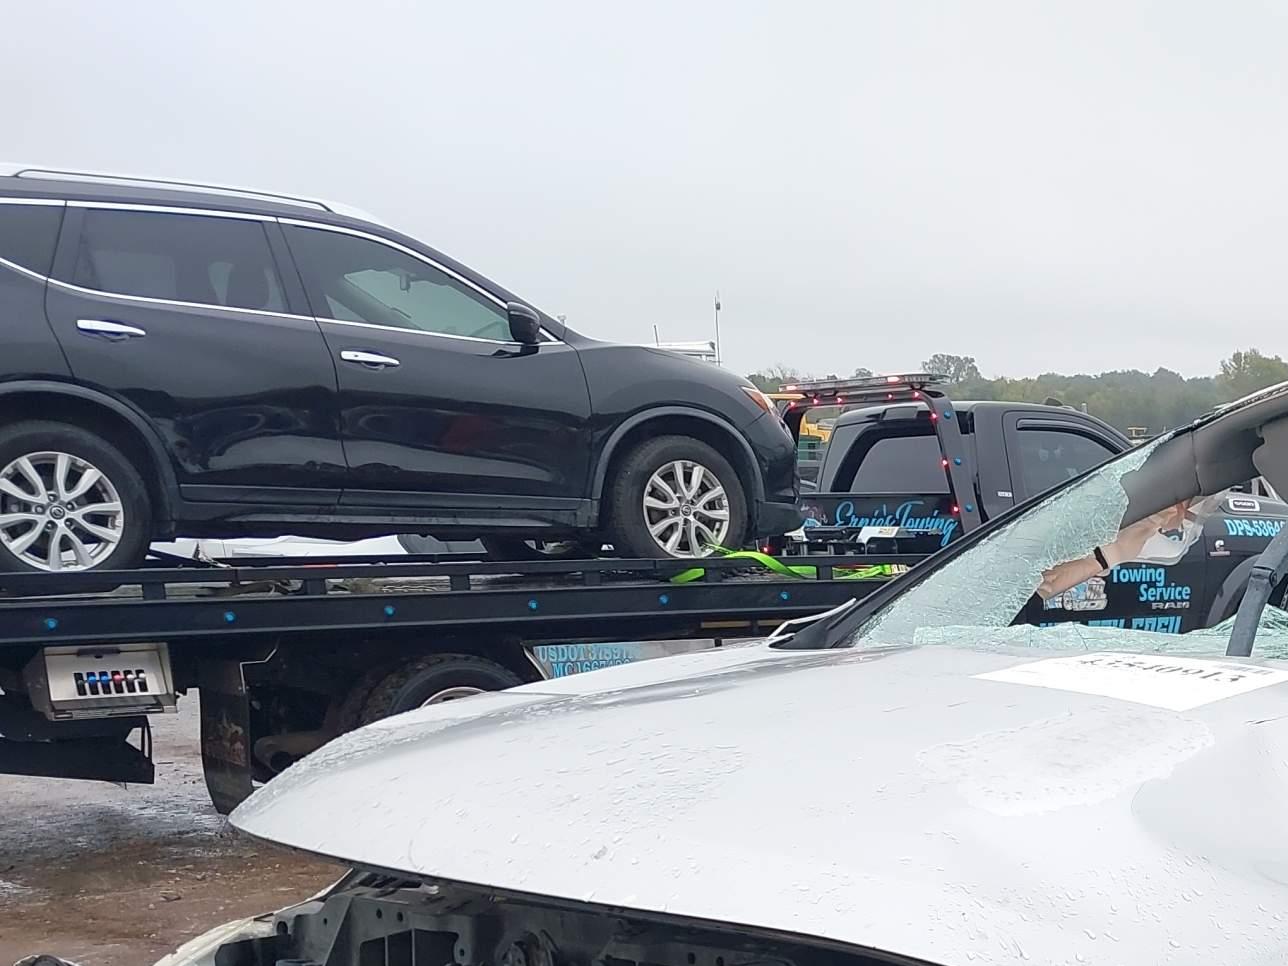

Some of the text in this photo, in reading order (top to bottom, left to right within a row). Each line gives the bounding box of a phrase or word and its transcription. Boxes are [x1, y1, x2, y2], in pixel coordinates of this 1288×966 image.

[895, 501, 958, 547] Towing
[1111, 564, 1166, 587] Towing
[1138, 582, 1192, 602] Service
[1151, 601, 1190, 610] RAM
